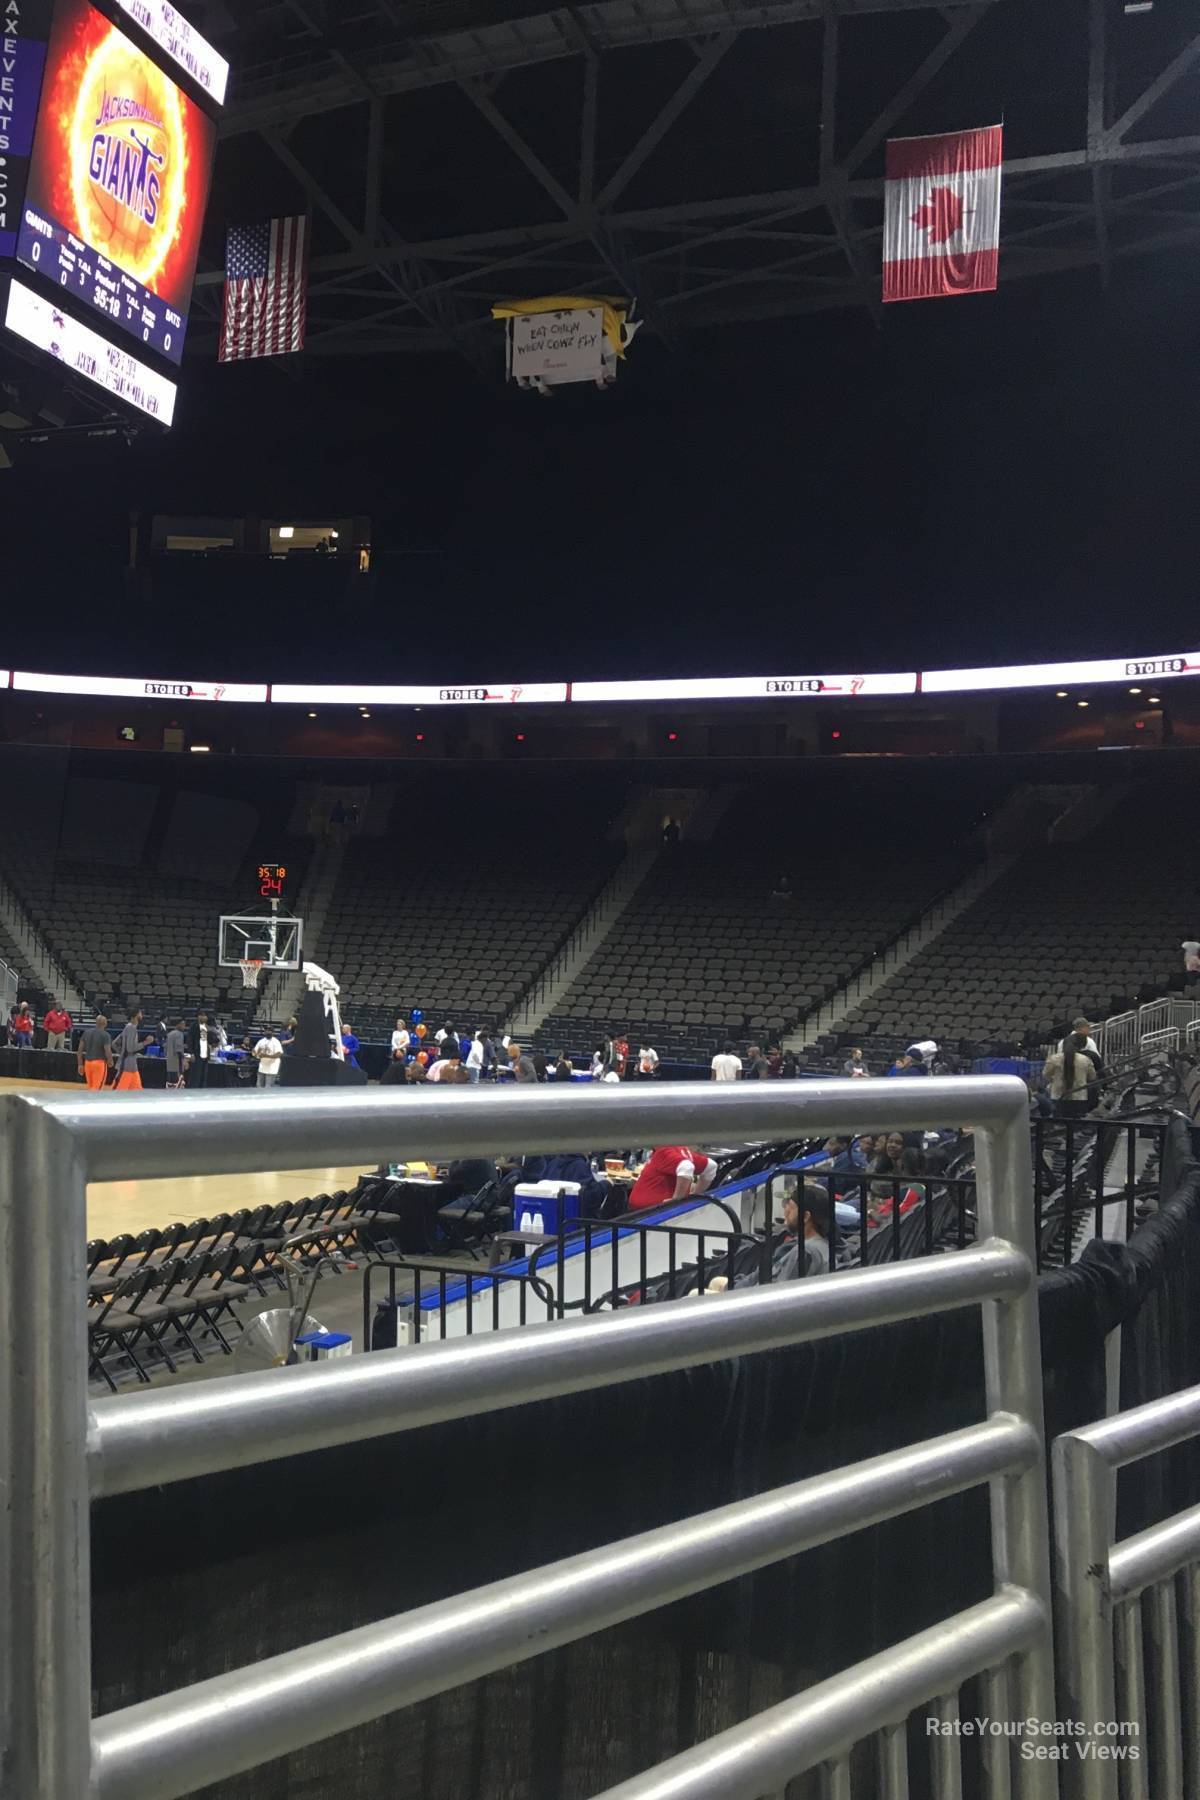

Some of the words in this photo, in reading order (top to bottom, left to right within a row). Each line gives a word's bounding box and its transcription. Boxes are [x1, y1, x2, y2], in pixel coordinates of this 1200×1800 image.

[89, 134, 161, 224] GIANTS
[32, 242, 41, 261] 0
[93, 285, 121, 317] 35:18
[165, 309, 181, 328] BATS
[164, 333, 171, 351] 0
[530, 327, 548, 340] EAT
[517, 339, 545, 355] WHEN
[578, 335, 597, 349] FLY
[1126, 659, 1183, 675] STONES
[145, 683, 190, 695] STONES
[440, 689, 485, 700] STONES
[767, 680, 820, 692] STONES
[258, 867, 286, 879] 35:18
[260, 878, 282, 895] 24
